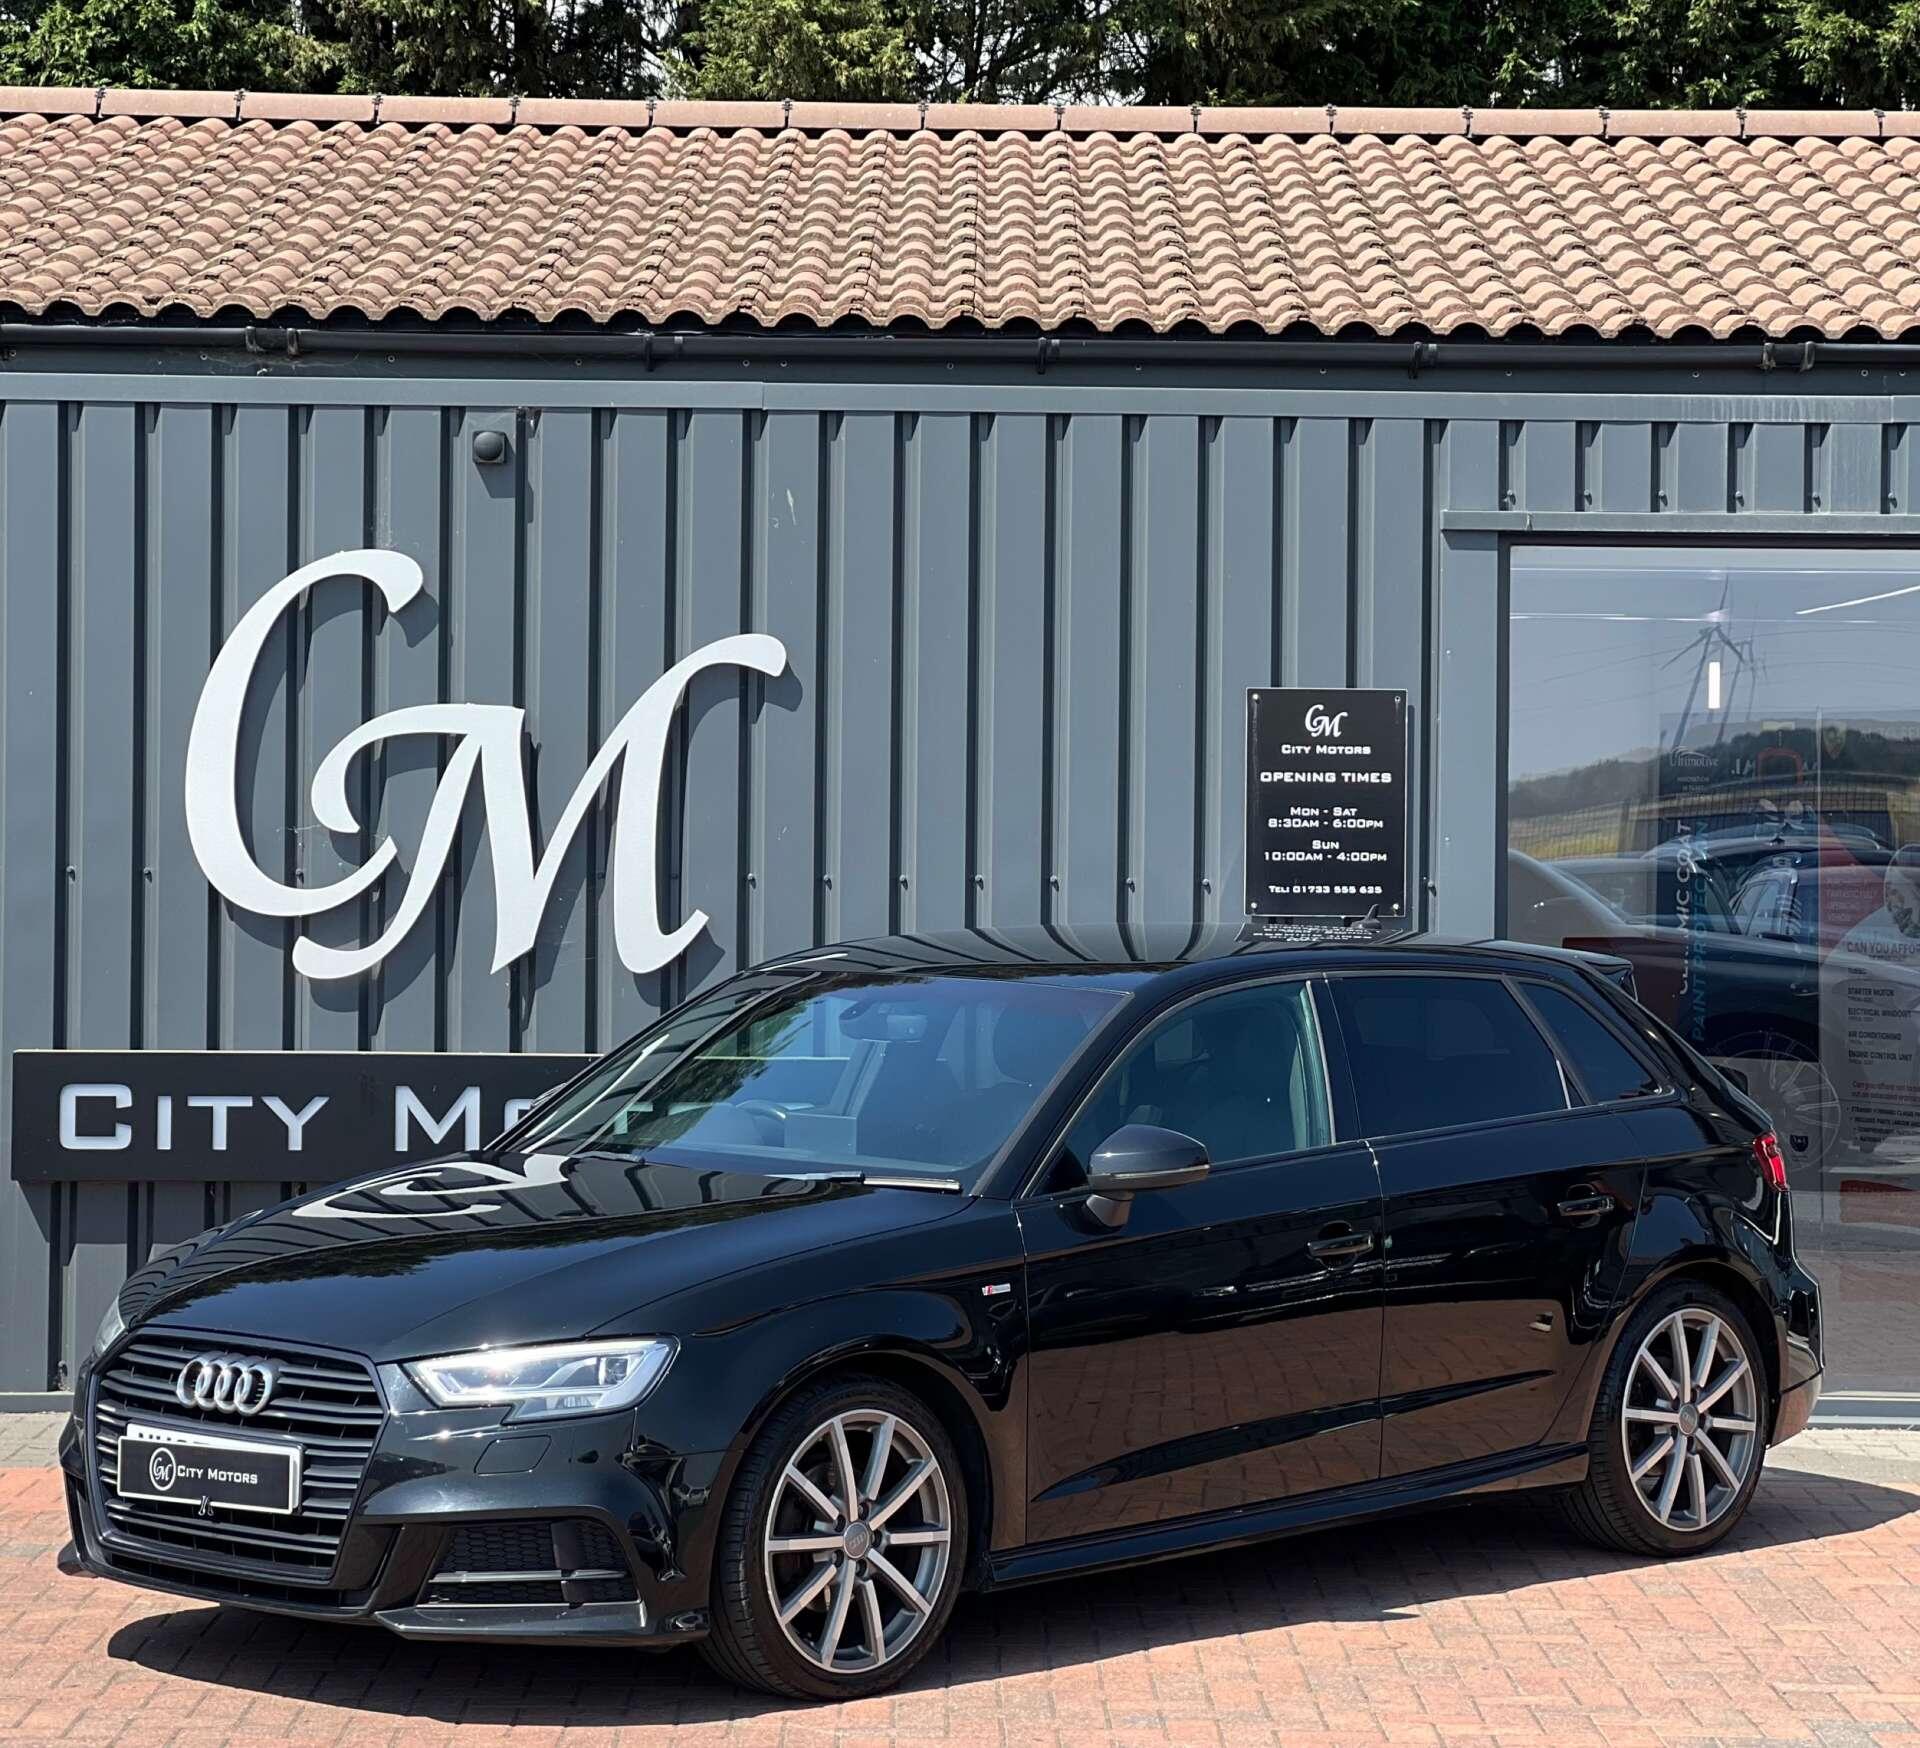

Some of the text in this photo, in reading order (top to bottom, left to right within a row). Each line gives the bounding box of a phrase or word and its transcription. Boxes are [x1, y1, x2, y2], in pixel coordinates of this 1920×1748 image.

[1304, 704, 1348, 737] CM
[1281, 744, 1371, 755] CITY MOTORS
[185, 549, 787, 980] CM
[1260, 771, 1392, 784] OPENING TIMES
[1290, 806, 1320, 817] MON
[1332, 806, 1358, 817] SAT
[1267, 818, 1320, 829] 8:30AM
[1332, 818, 1384, 829] 6:00PM
[1311, 839, 1340, 850] SUN
[1264, 851, 1324, 862] 10:00AM
[1336, 851, 1388, 862] 4:00PM
[1292, 885, 1331, 894] 01733
[1847, 941, 1867, 953] CAN
[1869, 942, 1889, 954] YOU
[1692, 974, 1706, 1041] PAINT
[58, 1083, 330, 1152] CITY
[177, 1464, 258, 1485] CITY MOTORS
